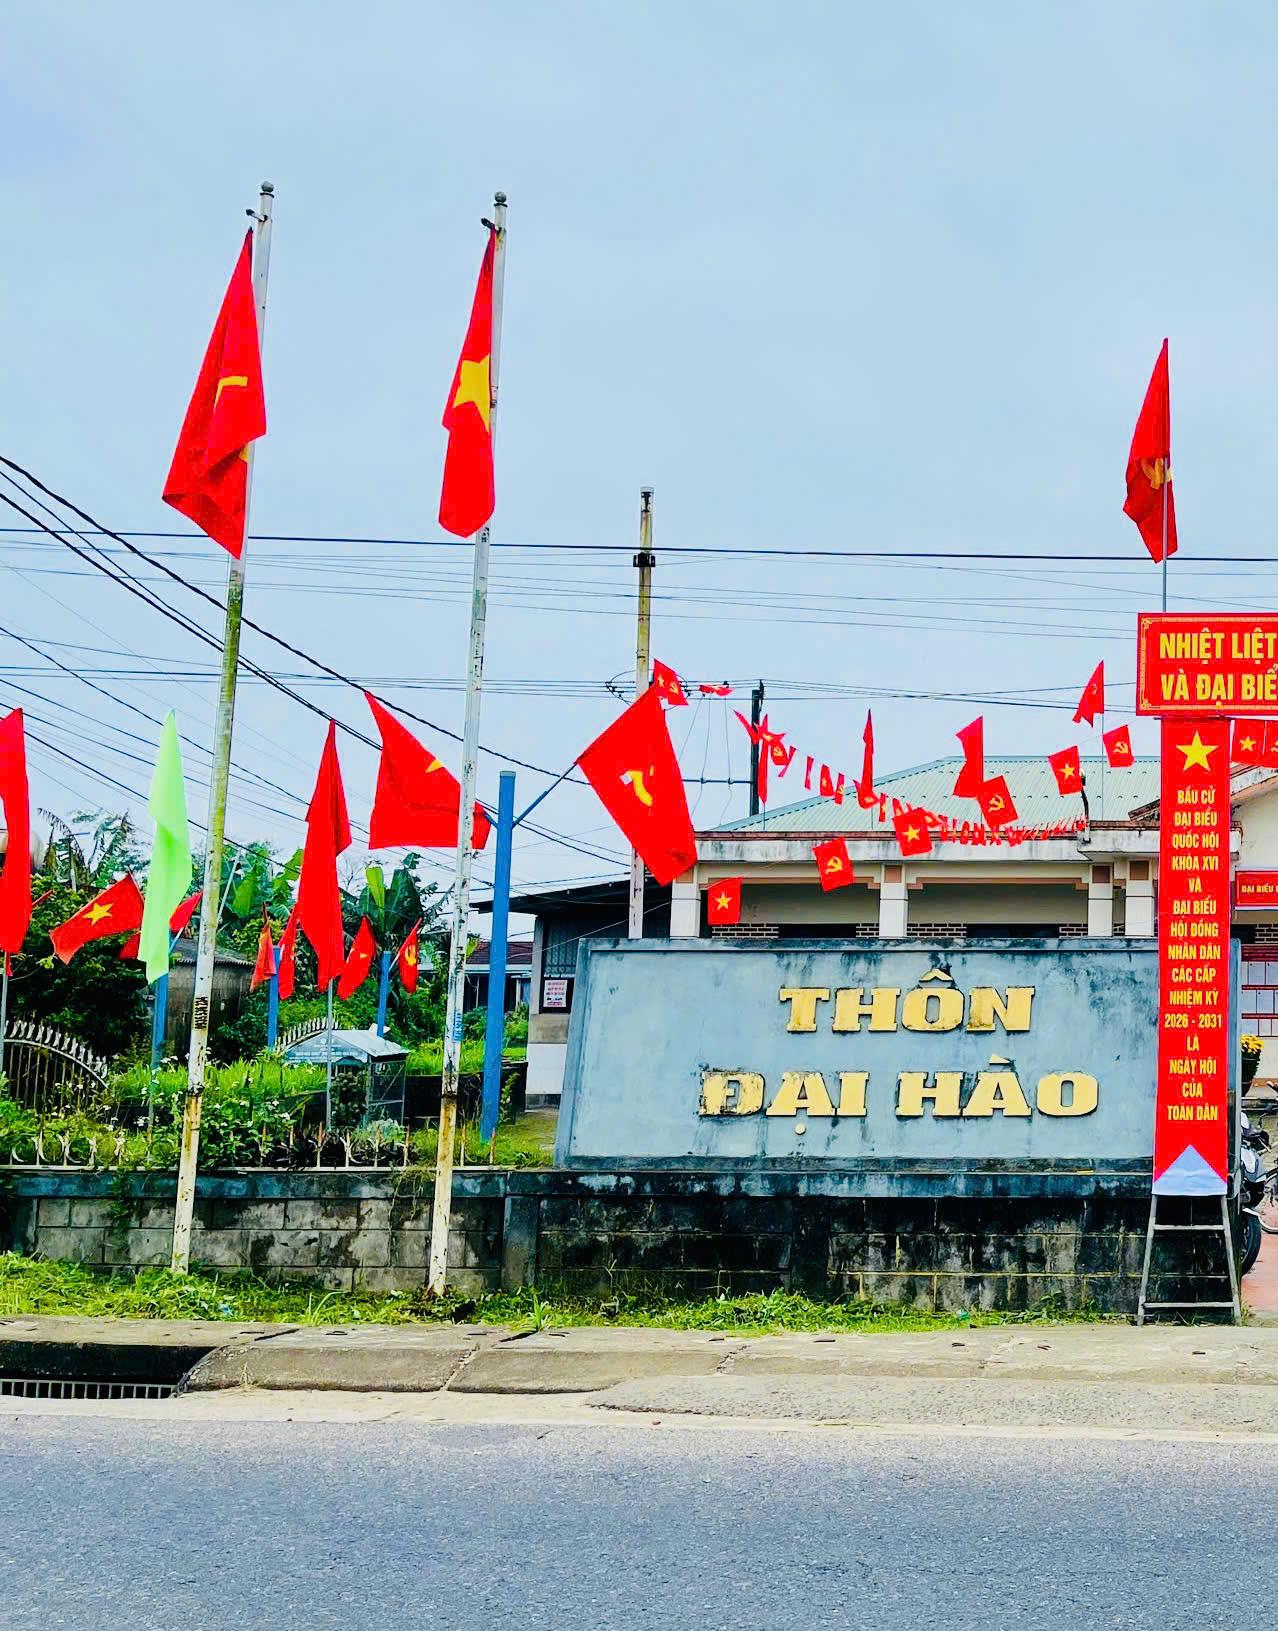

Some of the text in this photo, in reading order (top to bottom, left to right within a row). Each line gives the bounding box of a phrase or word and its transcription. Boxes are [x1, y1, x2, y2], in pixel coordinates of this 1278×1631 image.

[1159, 627, 1224, 664] NHIỆT
[1232, 627, 1277, 664] LIỆT
[1161, 668, 1189, 700] VÀ
[1195, 673, 1234, 708] ĐẠI
[1174, 807, 1217, 829] ĐẠI BIỂU
[1172, 830, 1219, 851] QUỐC HỘI
[1202, 856, 1218, 870] XVI
[1188, 877, 1201, 893] VÀ
[1173, 895, 1216, 917] ĐẠI BIỂU
[1168, 942, 1221, 960] NHÂN DÂN
[1172, 963, 1217, 982] CÁC CẤP
[779, 968, 1036, 1033] THÔN
[1169, 988, 1218, 1008] NHIỆM KỲ
[1165, 1014, 1189, 1028] 2026
[1198, 1014, 1222, 1028] 2031
[1186, 1034, 1200, 1051] LÀ
[1169, 1057, 1217, 1078] NGÀY HỘI
[699, 1054, 1099, 1135] ĐẠI HÀO
[1182, 1078, 1203, 1098] CỦA
[1168, 1103, 1218, 1121] TOÀN DÂN
